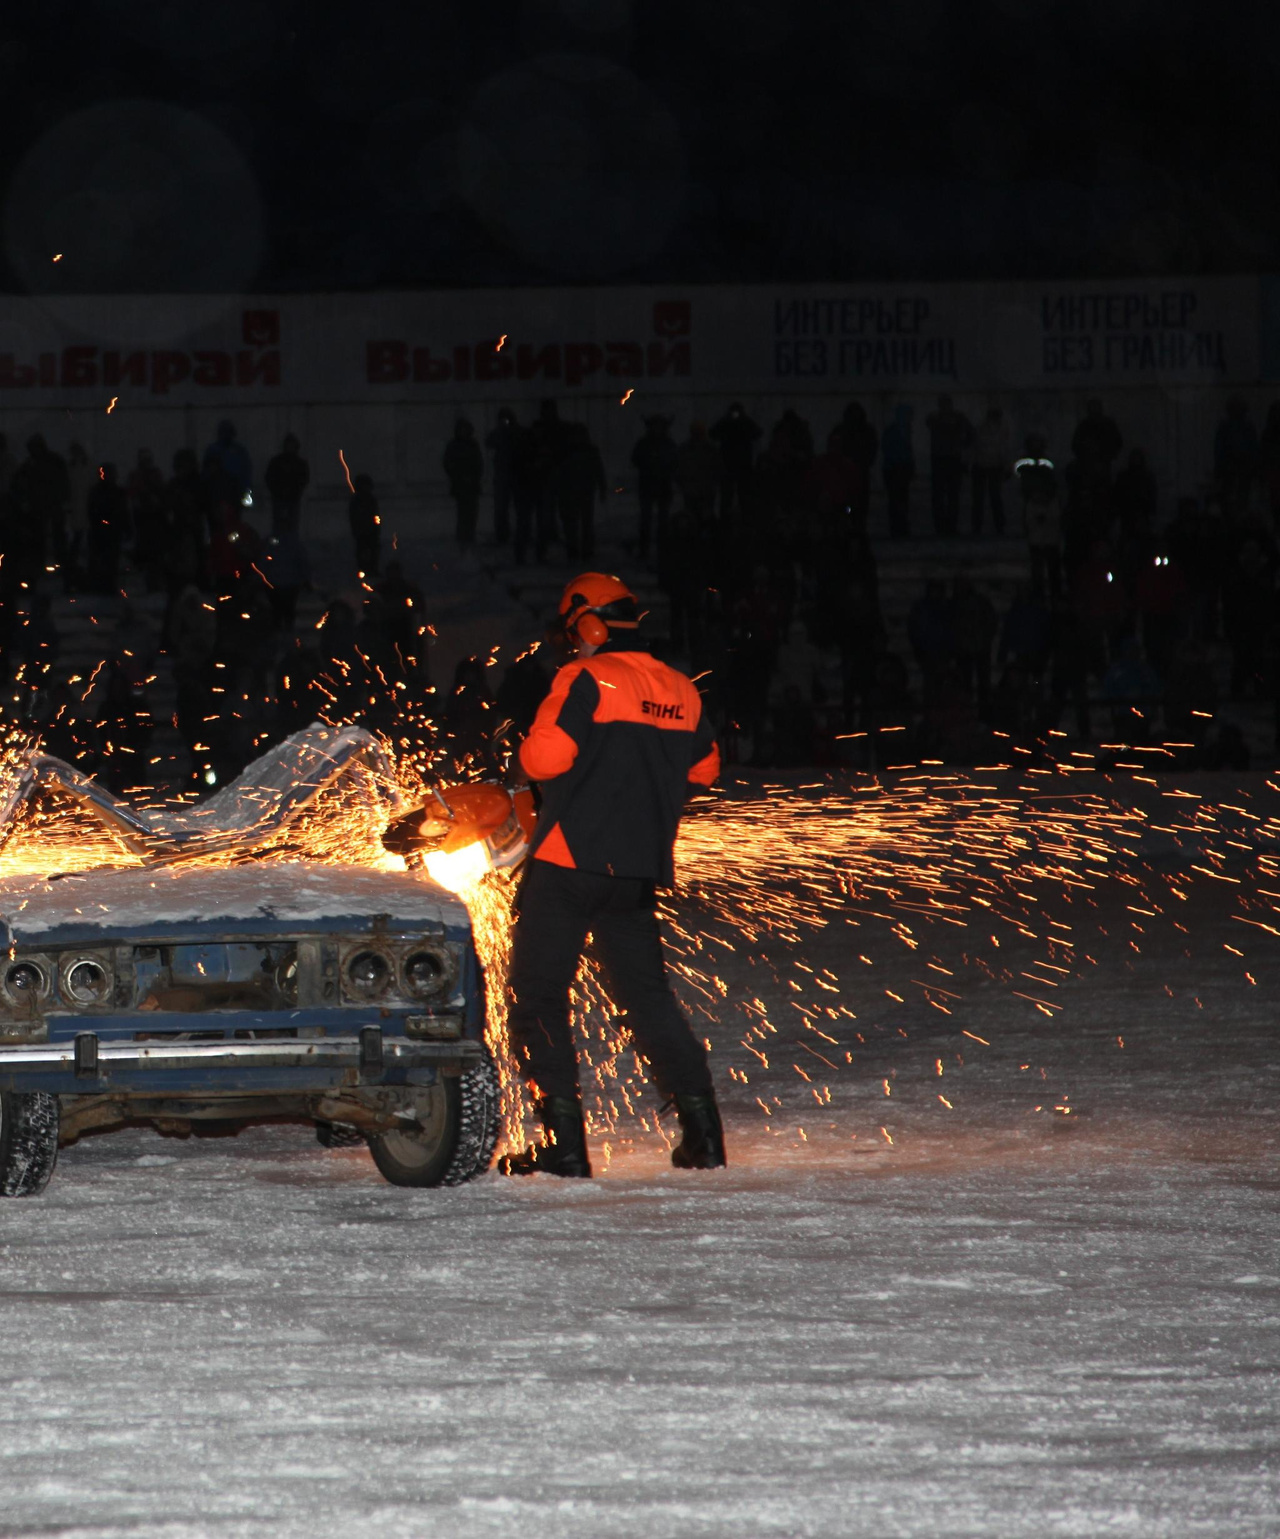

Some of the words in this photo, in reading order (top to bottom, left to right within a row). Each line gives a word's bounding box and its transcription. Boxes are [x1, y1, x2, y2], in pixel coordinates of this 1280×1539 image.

[772, 298, 931, 336] ИНТЕРЬЕР
[1041, 291, 1197, 330] ИНТЕРЬЕР
[773, 338, 829, 377] БЕЗ
[838, 338, 959, 381] ГРАНИЦ
[1041, 334, 1094, 374] БЕЗ
[1104, 330, 1228, 376] ГРАНИЦ
[642, 700, 685, 720] STIHL
